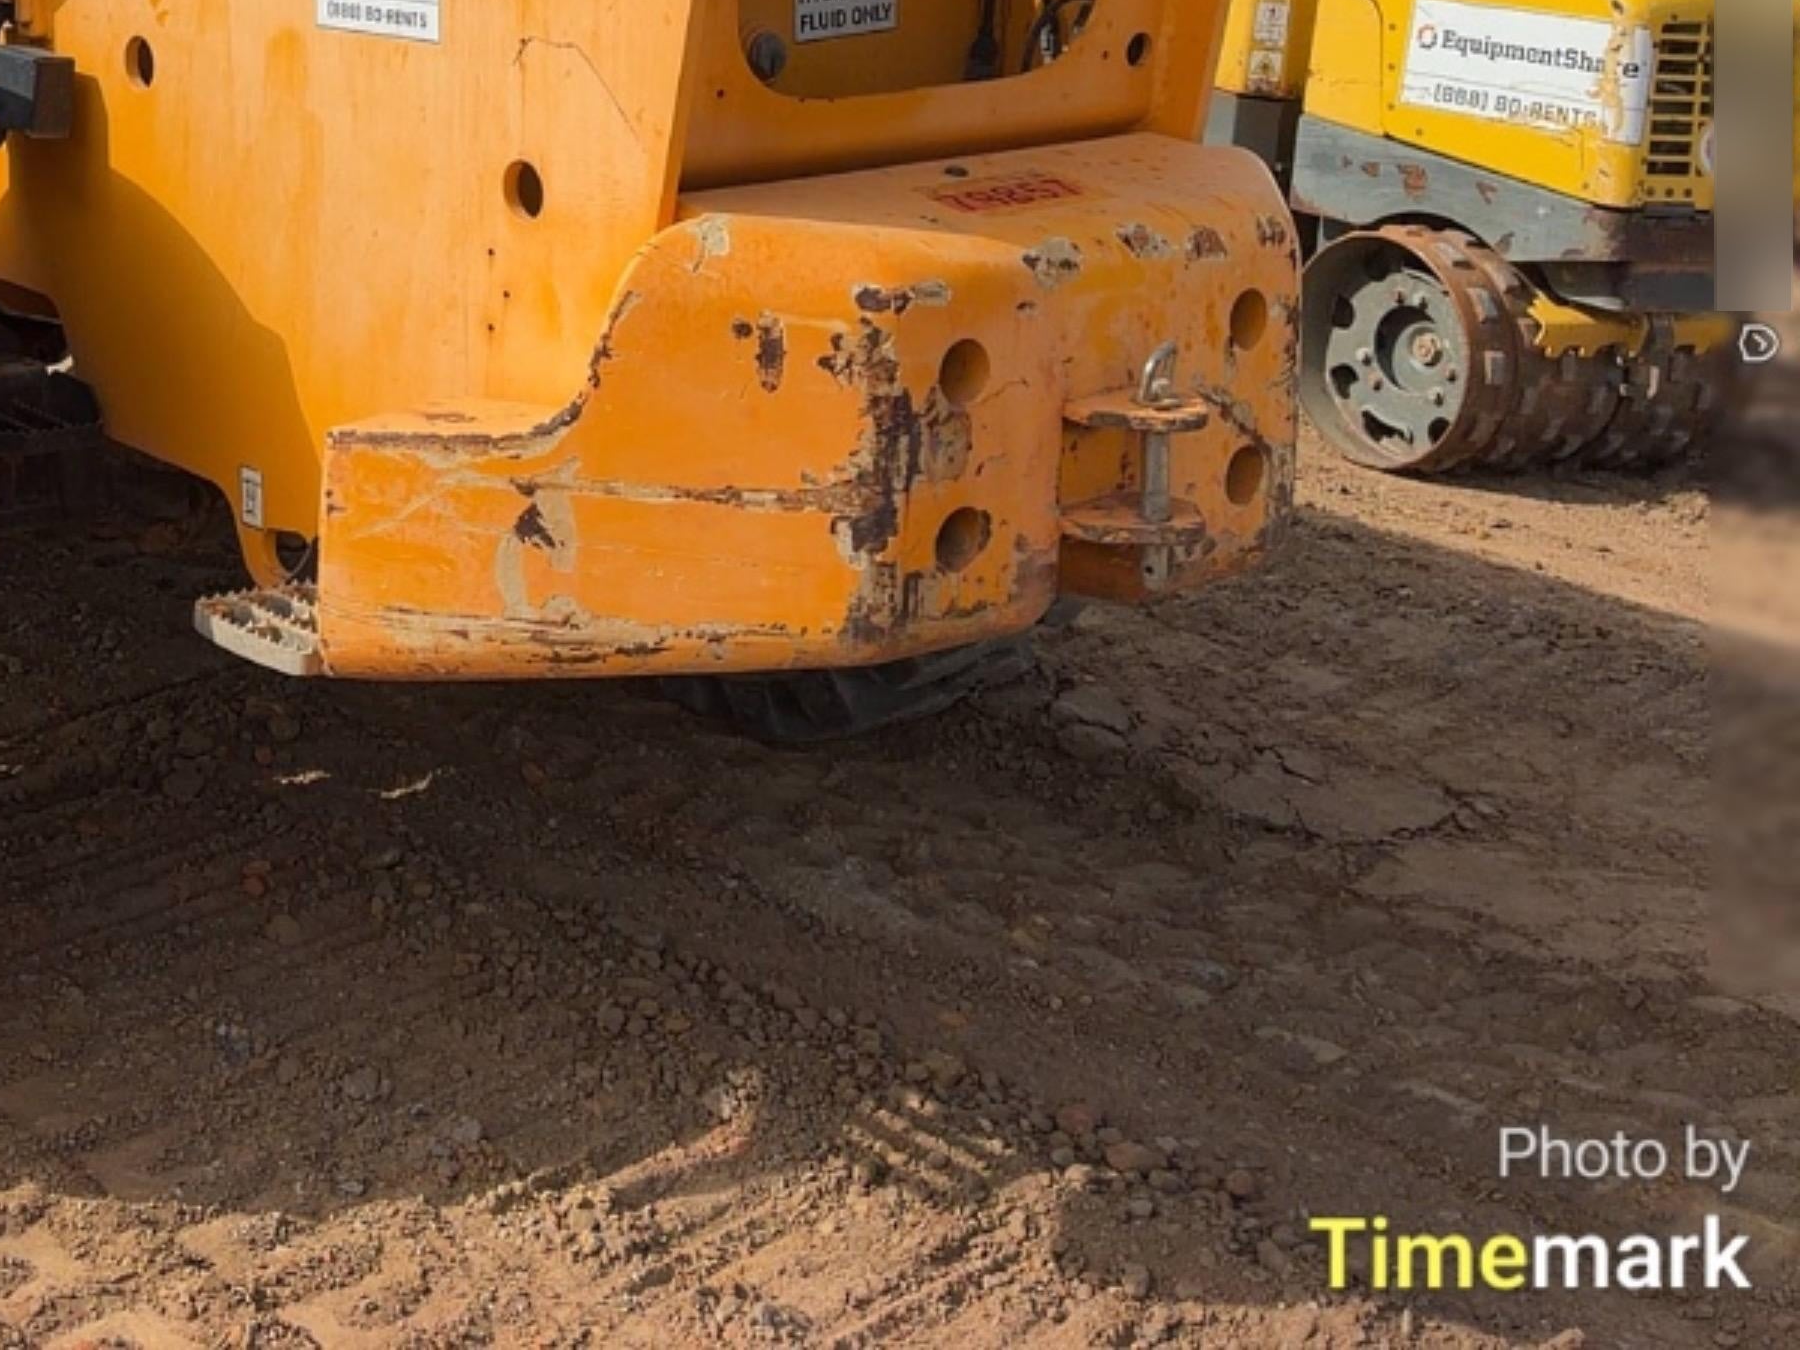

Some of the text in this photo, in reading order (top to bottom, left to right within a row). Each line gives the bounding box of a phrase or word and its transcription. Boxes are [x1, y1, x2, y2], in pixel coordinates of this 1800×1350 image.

[800, 2, 893, 35] FLUID ONLY
[1441, 28, 1641, 79] EquipmentShae
